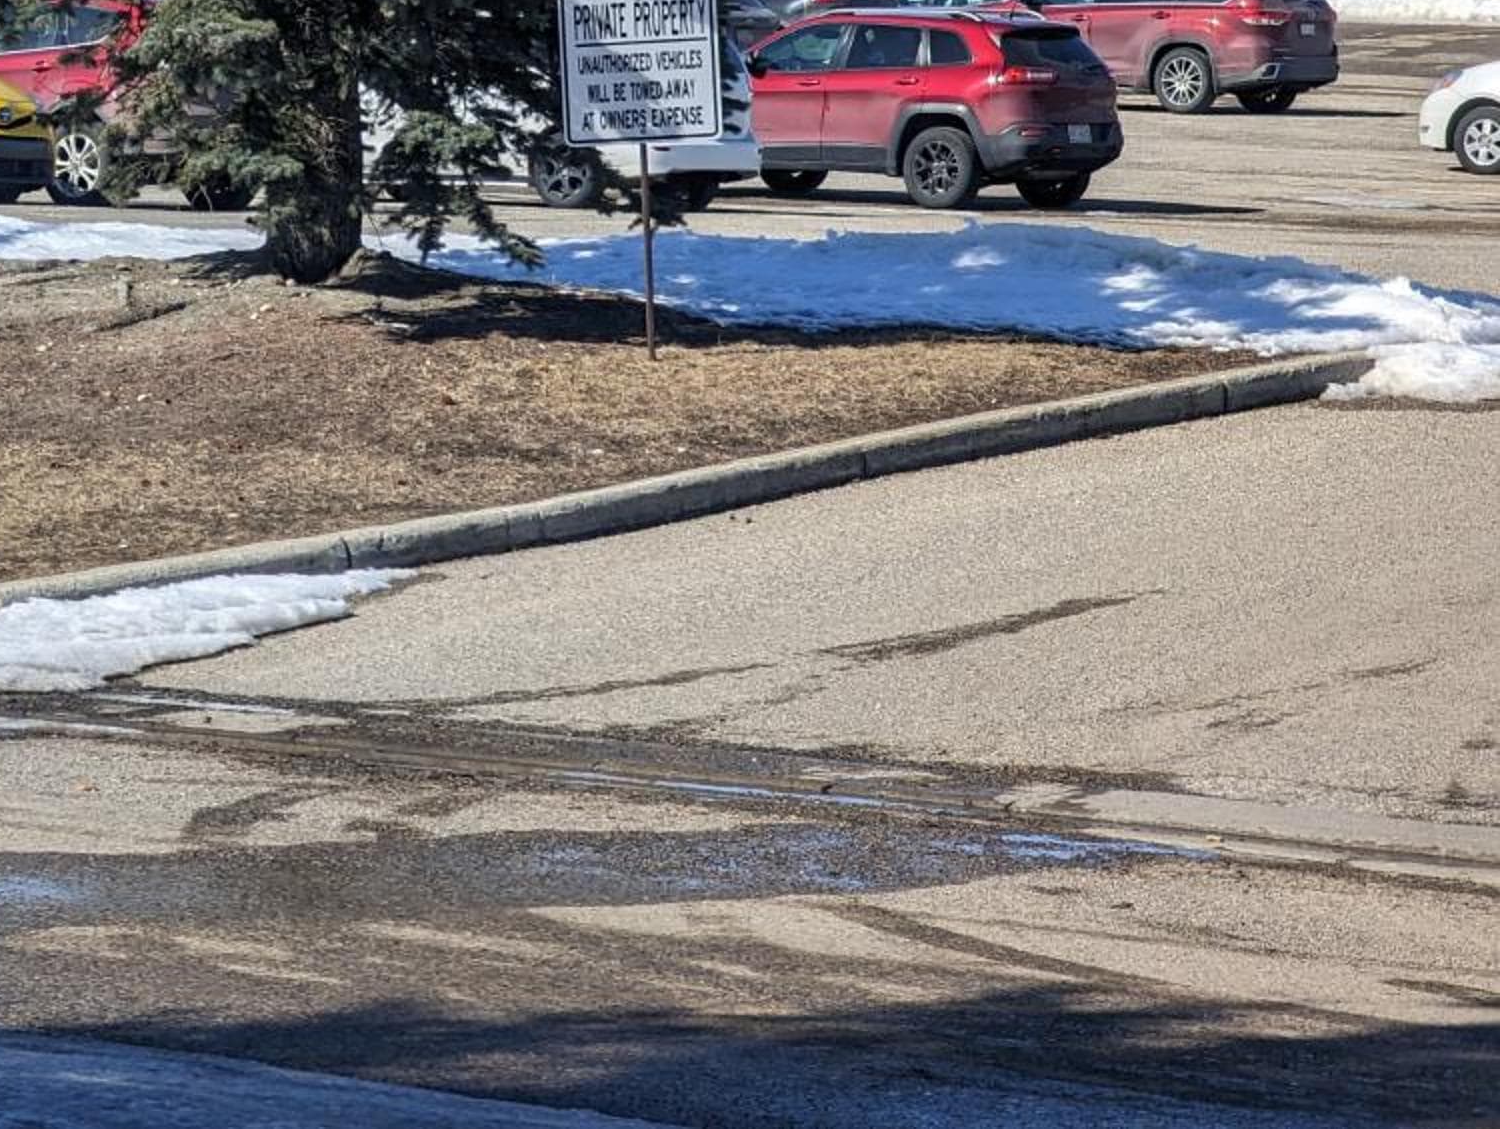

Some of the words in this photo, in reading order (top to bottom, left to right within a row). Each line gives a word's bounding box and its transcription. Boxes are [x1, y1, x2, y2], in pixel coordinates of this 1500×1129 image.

[573, 2, 627, 40] PRIVATE
[577, 53, 653, 75] UNAUTHORIZED
[656, 50, 703, 70] VEHICLES
[587, 84, 610, 103] WILL
[613, 82, 626, 102] BE
[630, 80, 663, 101] TOWED
[665, 79, 696, 99] AWAY
[581, 112, 595, 132] AT
[600, 109, 647, 130] OWNERS
[652, 106, 704, 128] EXPENSE
